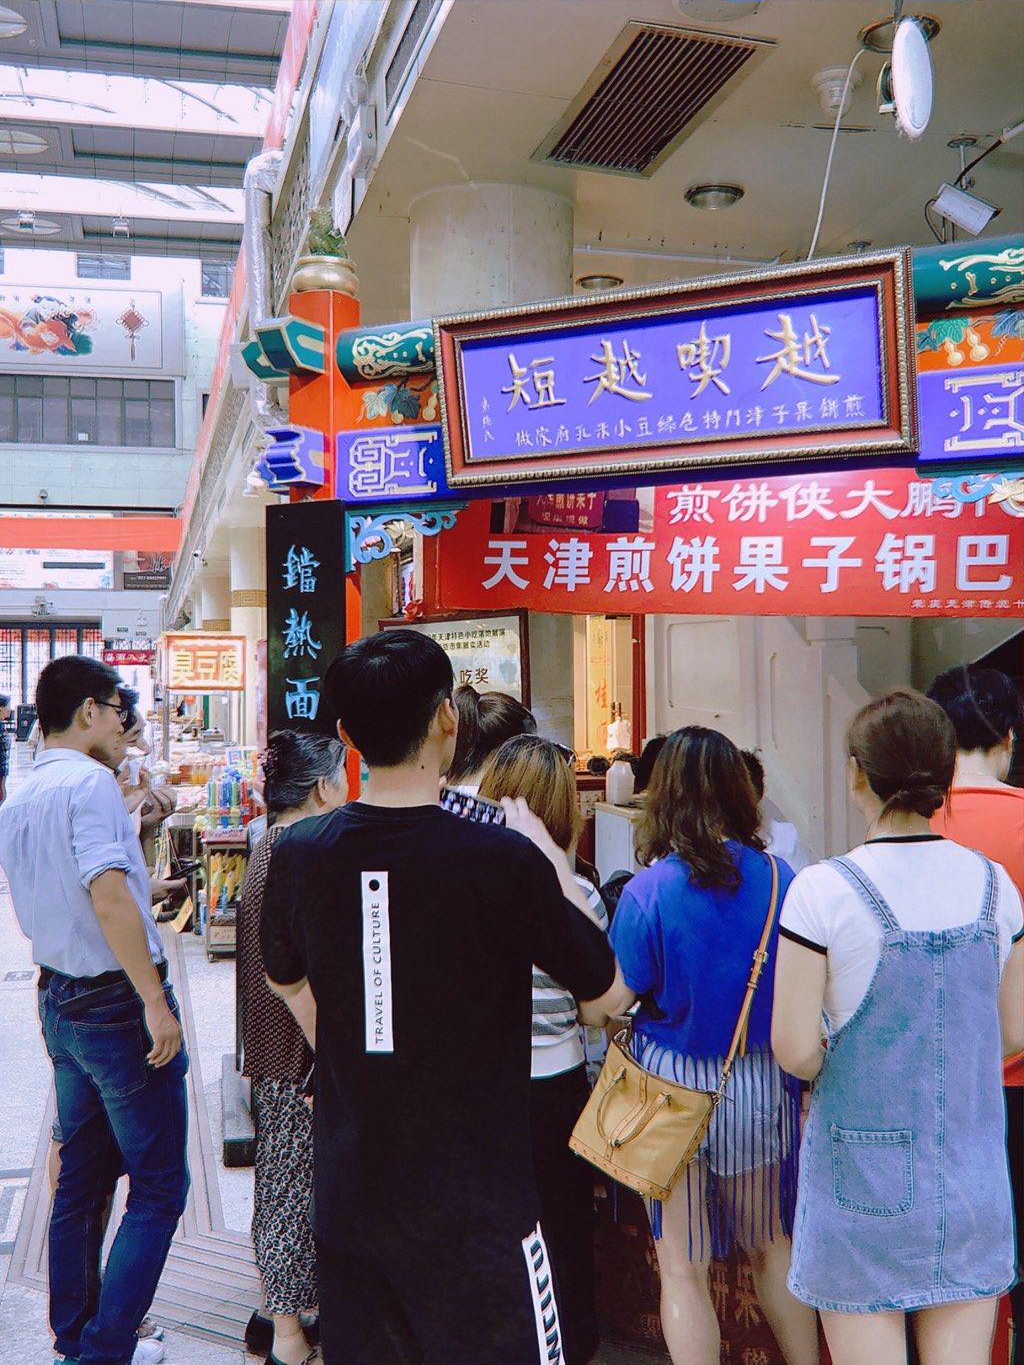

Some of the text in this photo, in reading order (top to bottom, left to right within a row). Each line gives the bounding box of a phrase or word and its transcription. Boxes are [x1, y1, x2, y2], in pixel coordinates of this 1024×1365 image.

[482, 533, 1014, 594] 天津煎饼果子锅巴
[173, 648, 242, 683] 臭豆腐
[373, 902, 384, 1045] TRAVEL OF CULTURE
